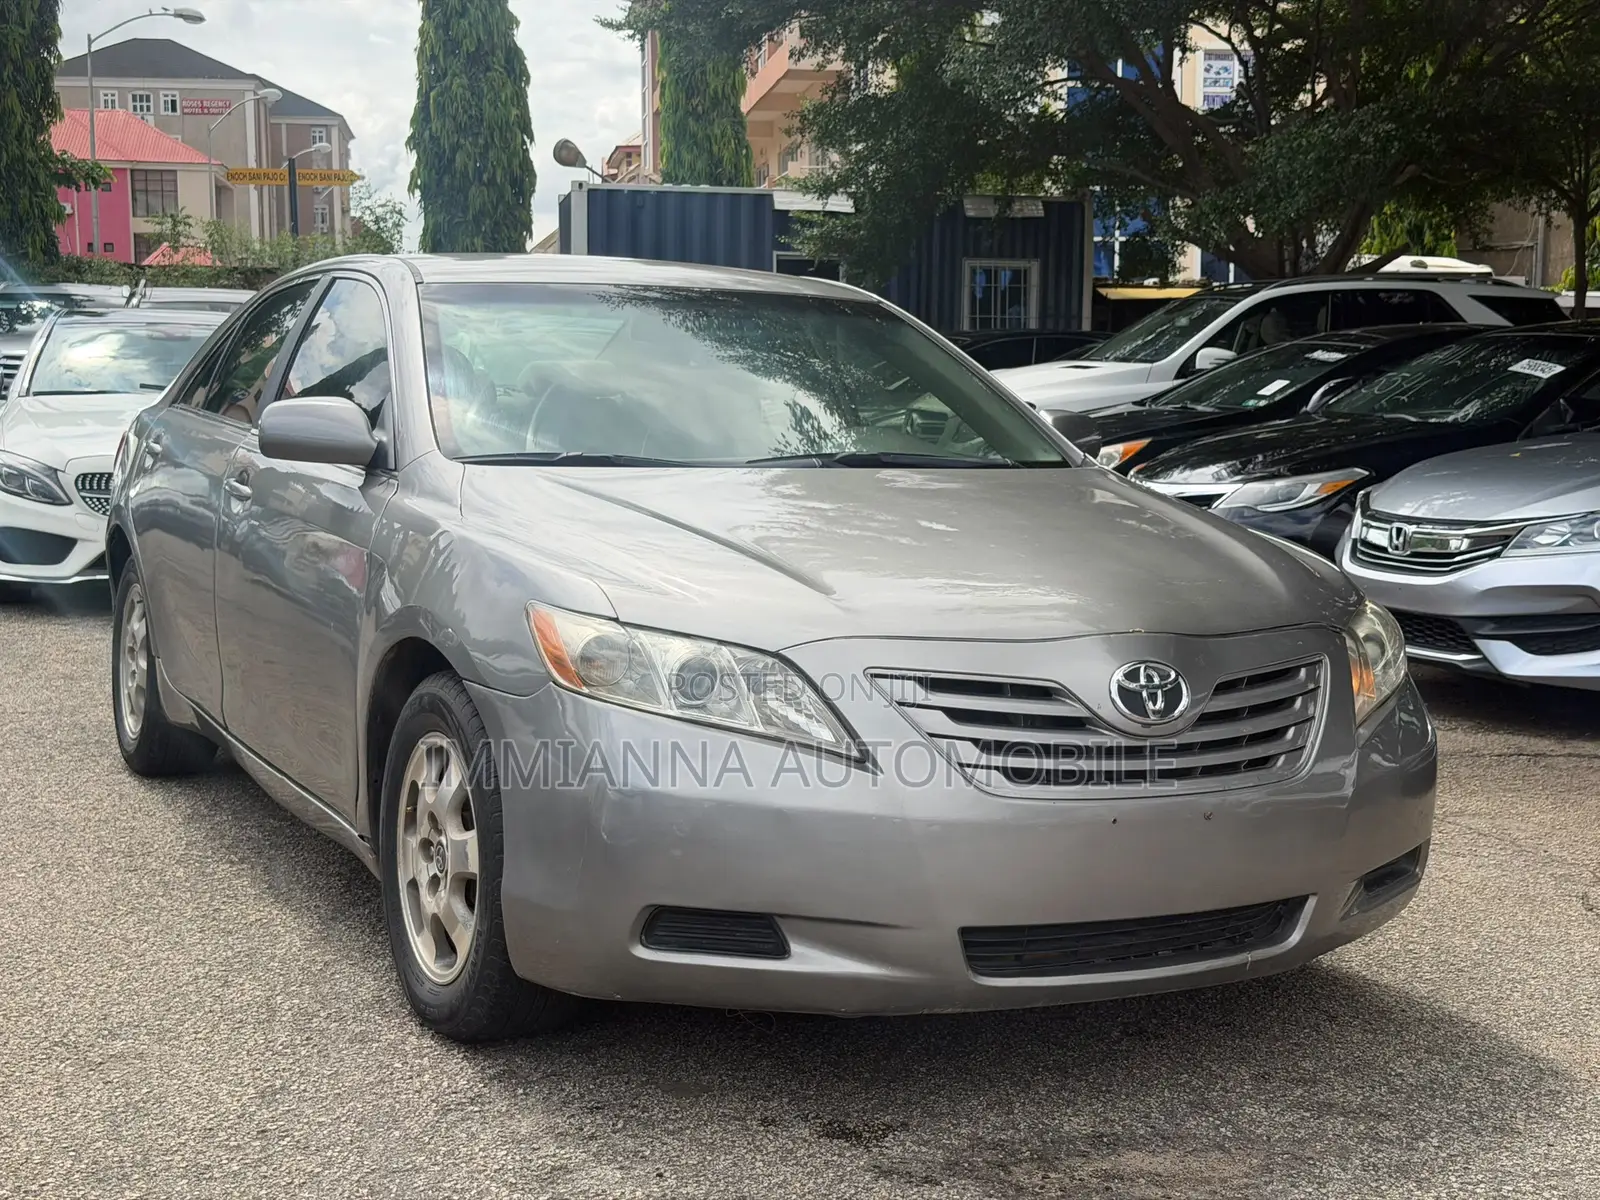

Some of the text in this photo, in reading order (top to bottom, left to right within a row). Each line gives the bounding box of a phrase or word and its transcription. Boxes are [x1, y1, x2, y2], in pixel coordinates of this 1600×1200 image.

[182, 100, 202, 108] ROSES
[227, 171, 248, 181] ENOCH
[248, 171, 262, 181] SANI
[263, 172, 278, 181] PAJO
[298, 172, 318, 181] ENOCH
[319, 172, 333, 182] SANI
